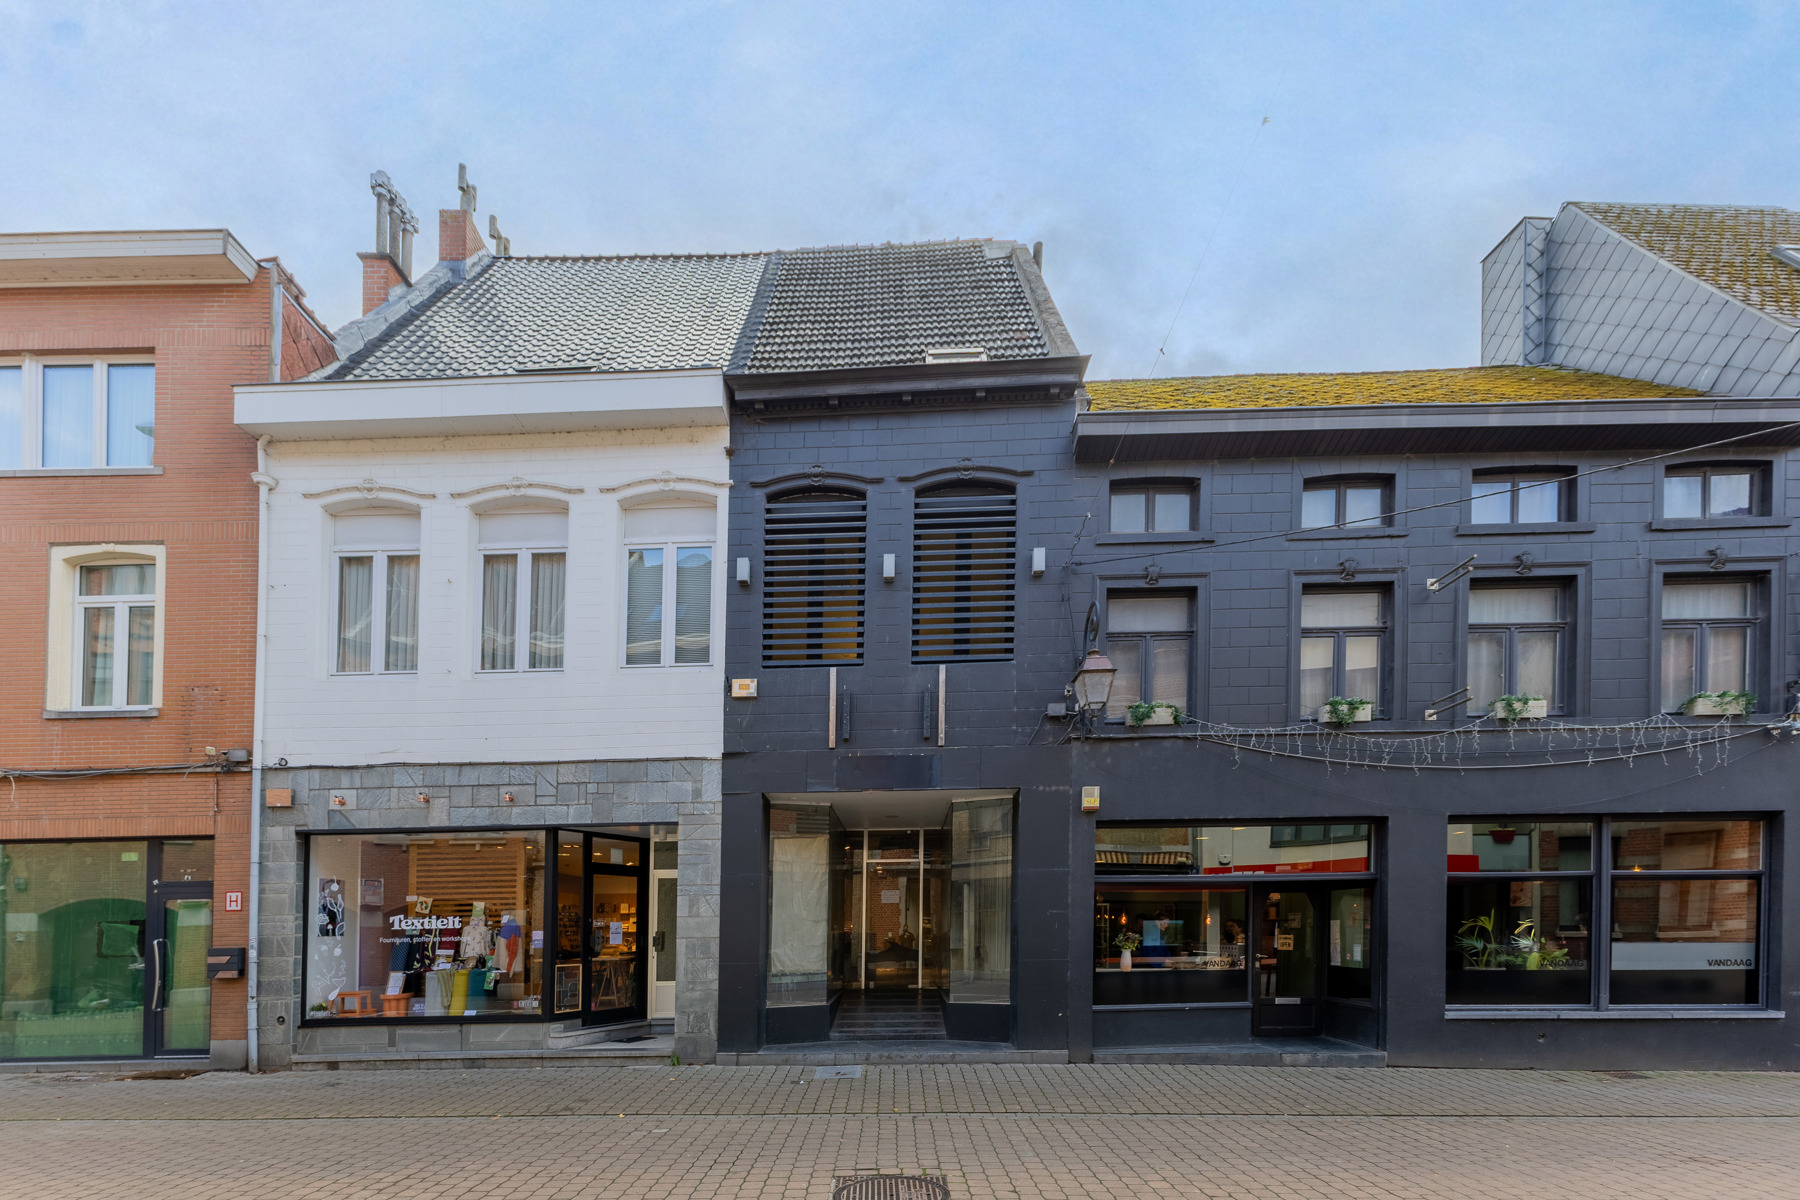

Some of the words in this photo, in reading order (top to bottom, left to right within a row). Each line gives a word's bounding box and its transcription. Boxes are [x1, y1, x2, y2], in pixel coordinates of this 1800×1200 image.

[229, 895, 239, 908] H
[389, 914, 462, 930] Textielt
[1203, 960, 1244, 968] VANDAAG
[1707, 959, 1753, 967] VANDAAG
